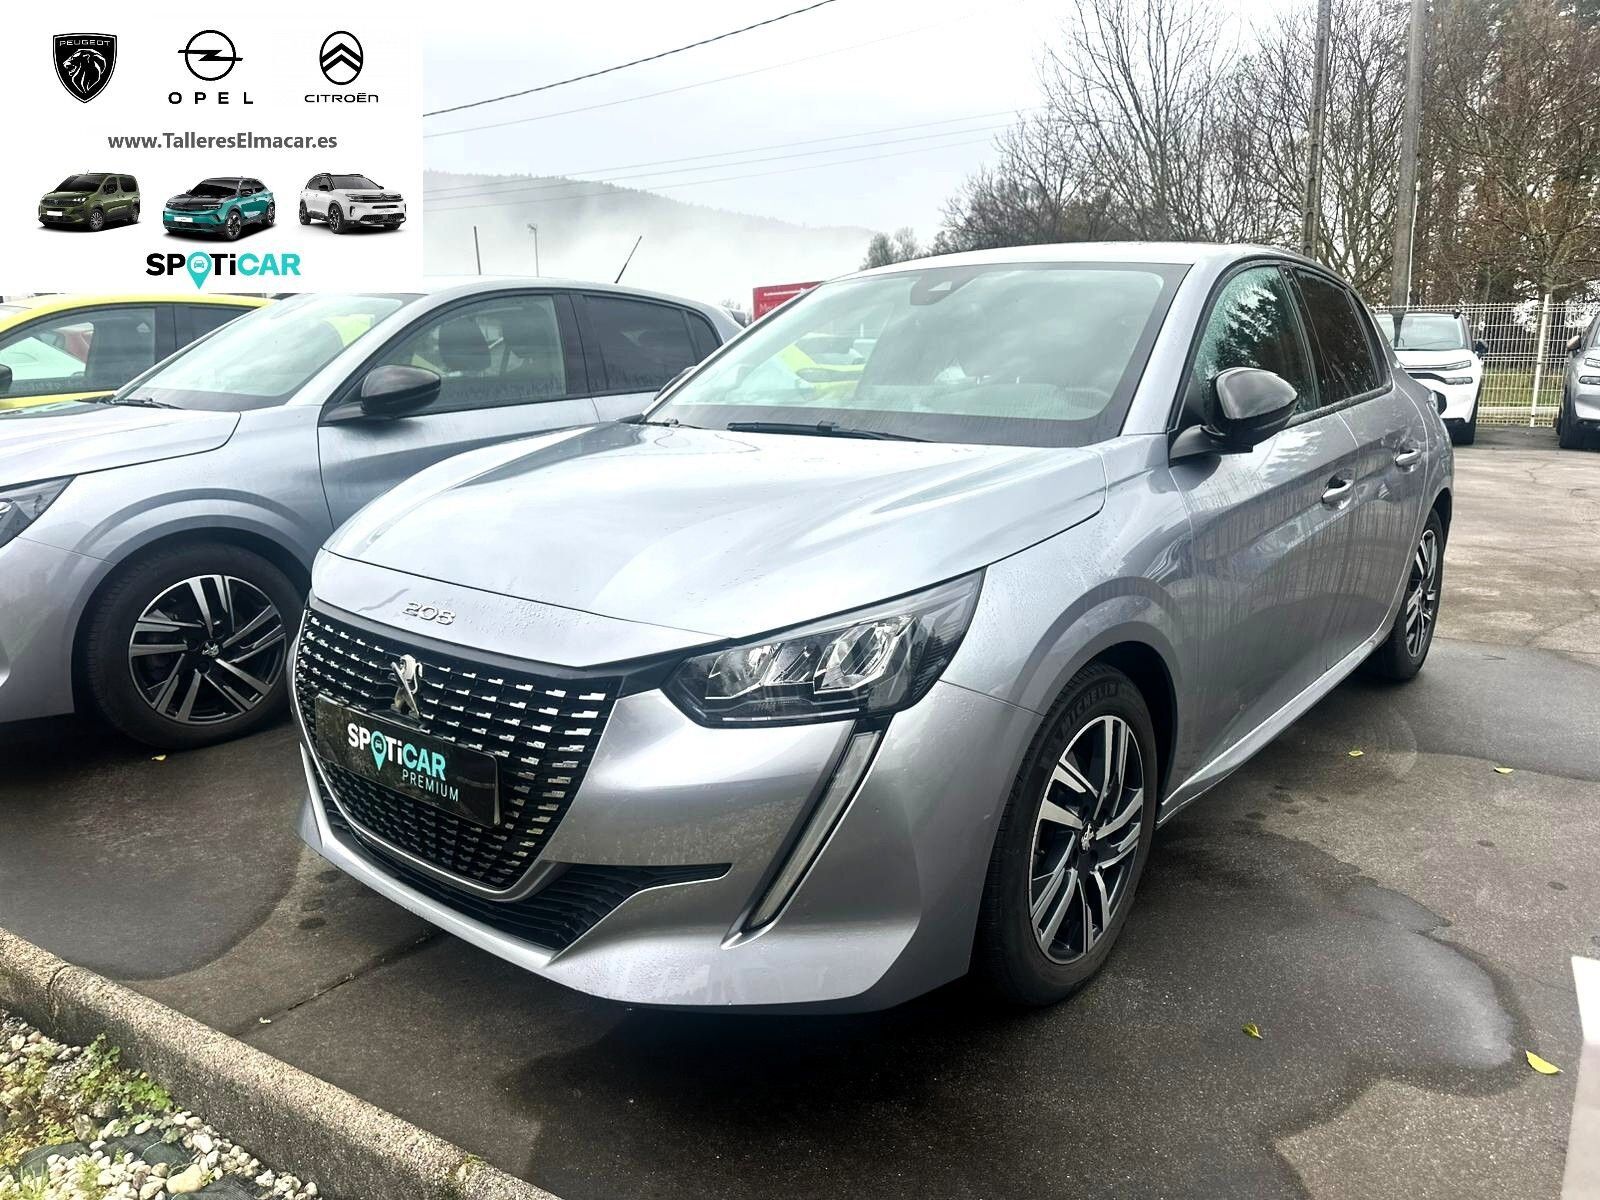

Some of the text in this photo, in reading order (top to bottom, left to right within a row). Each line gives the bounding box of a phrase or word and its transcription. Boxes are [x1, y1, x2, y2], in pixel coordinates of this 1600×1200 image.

[402, 602, 456, 625] 208
[1060, 683, 1118, 737] MICHELIN
[402, 769, 460, 802] PREMIUM
